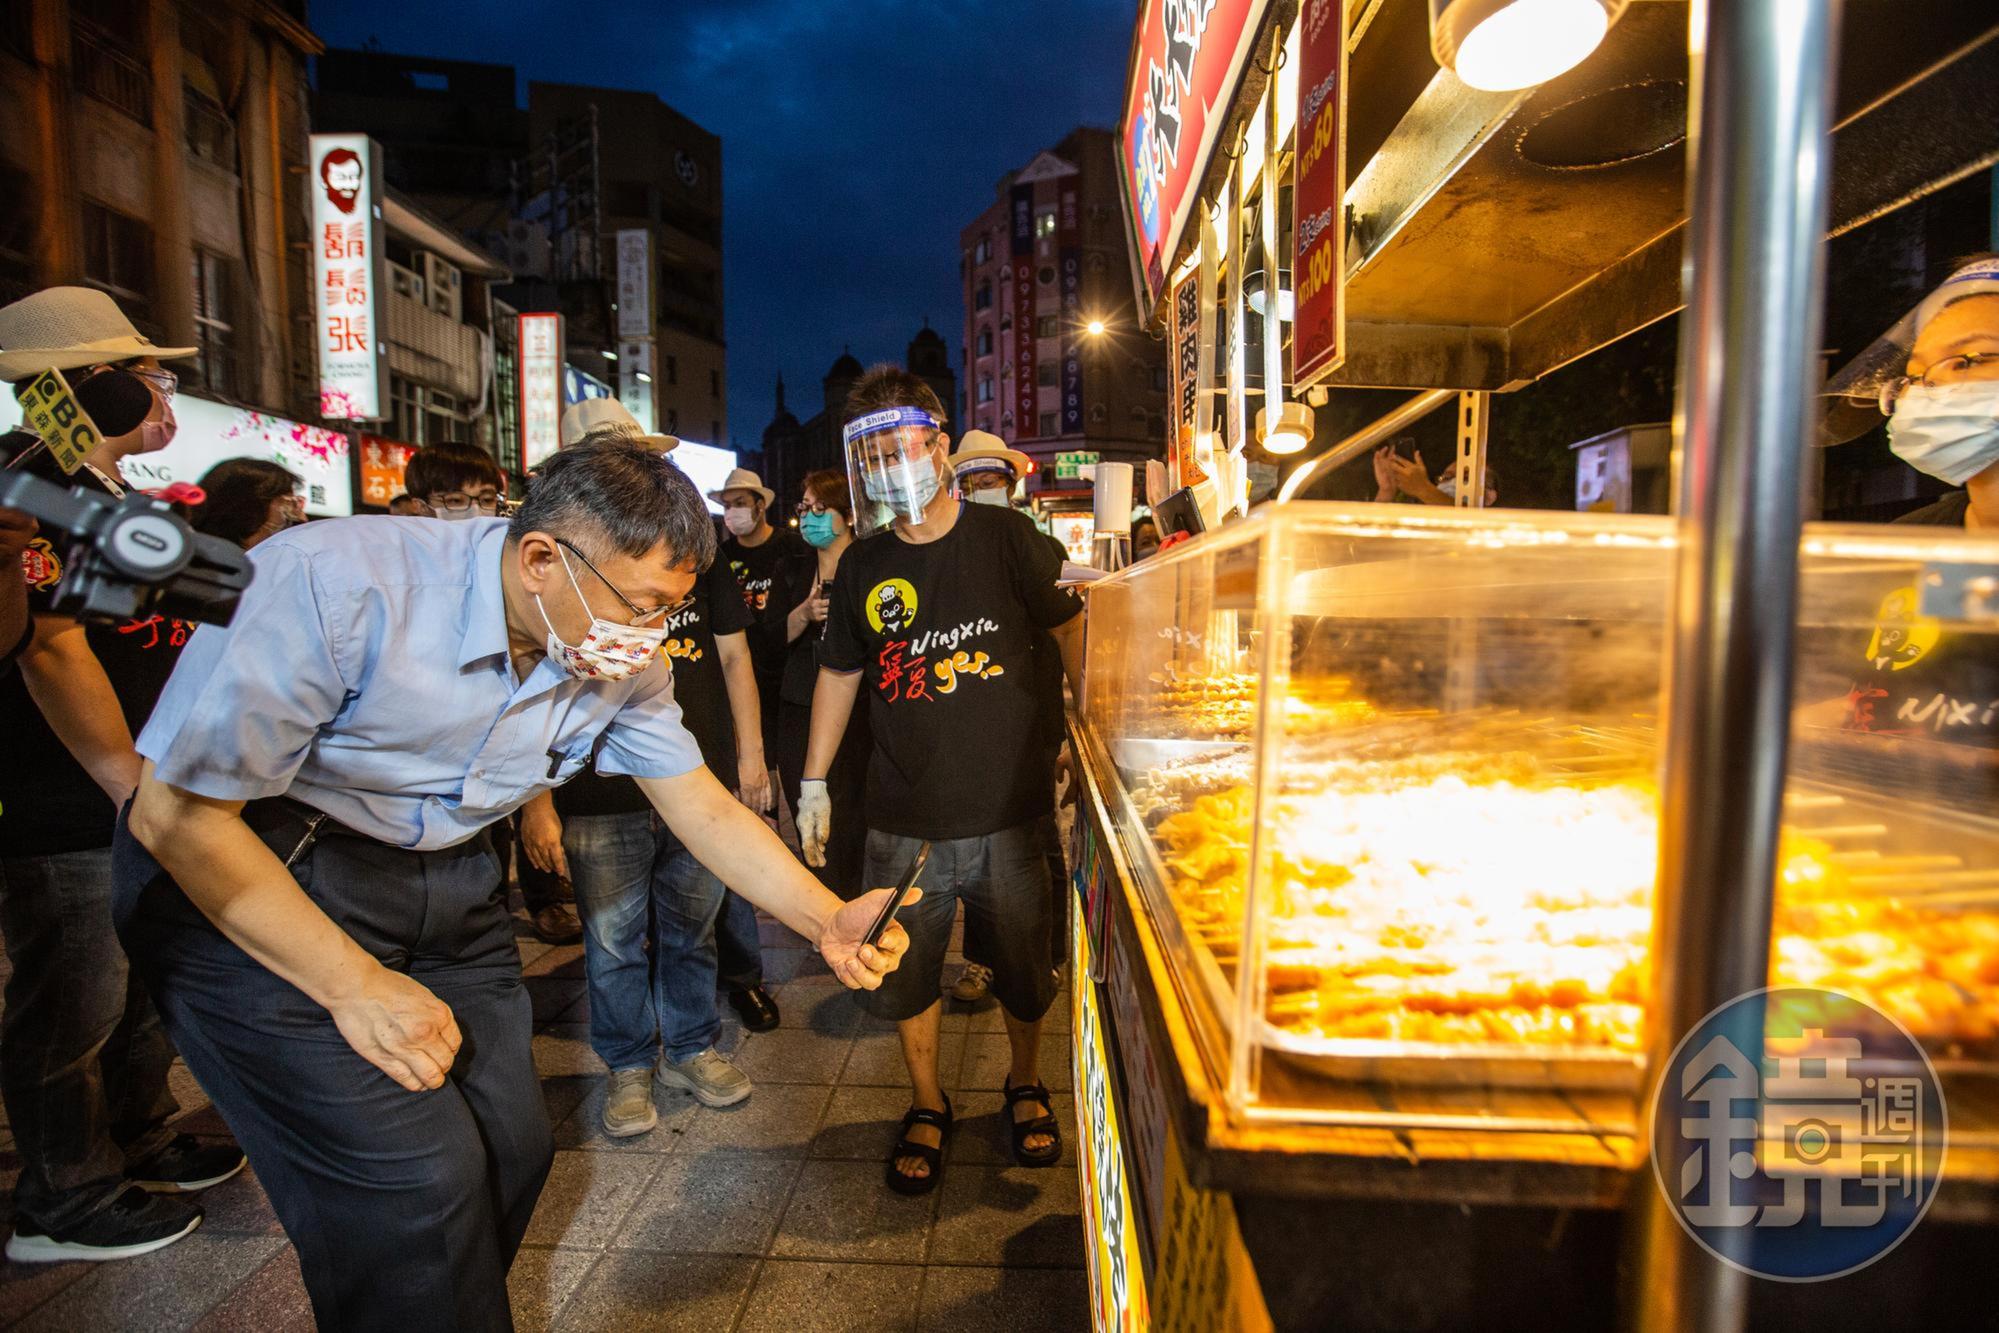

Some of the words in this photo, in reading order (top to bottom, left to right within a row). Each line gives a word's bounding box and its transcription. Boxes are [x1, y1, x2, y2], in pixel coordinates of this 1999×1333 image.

[23, 393, 78, 470] 東森新聞
[35, 373, 95, 453] EBC
[865, 411, 896, 426] Shield
[911, 617, 999, 656] Ningxia
[879, 640, 934, 703] 寧夏
